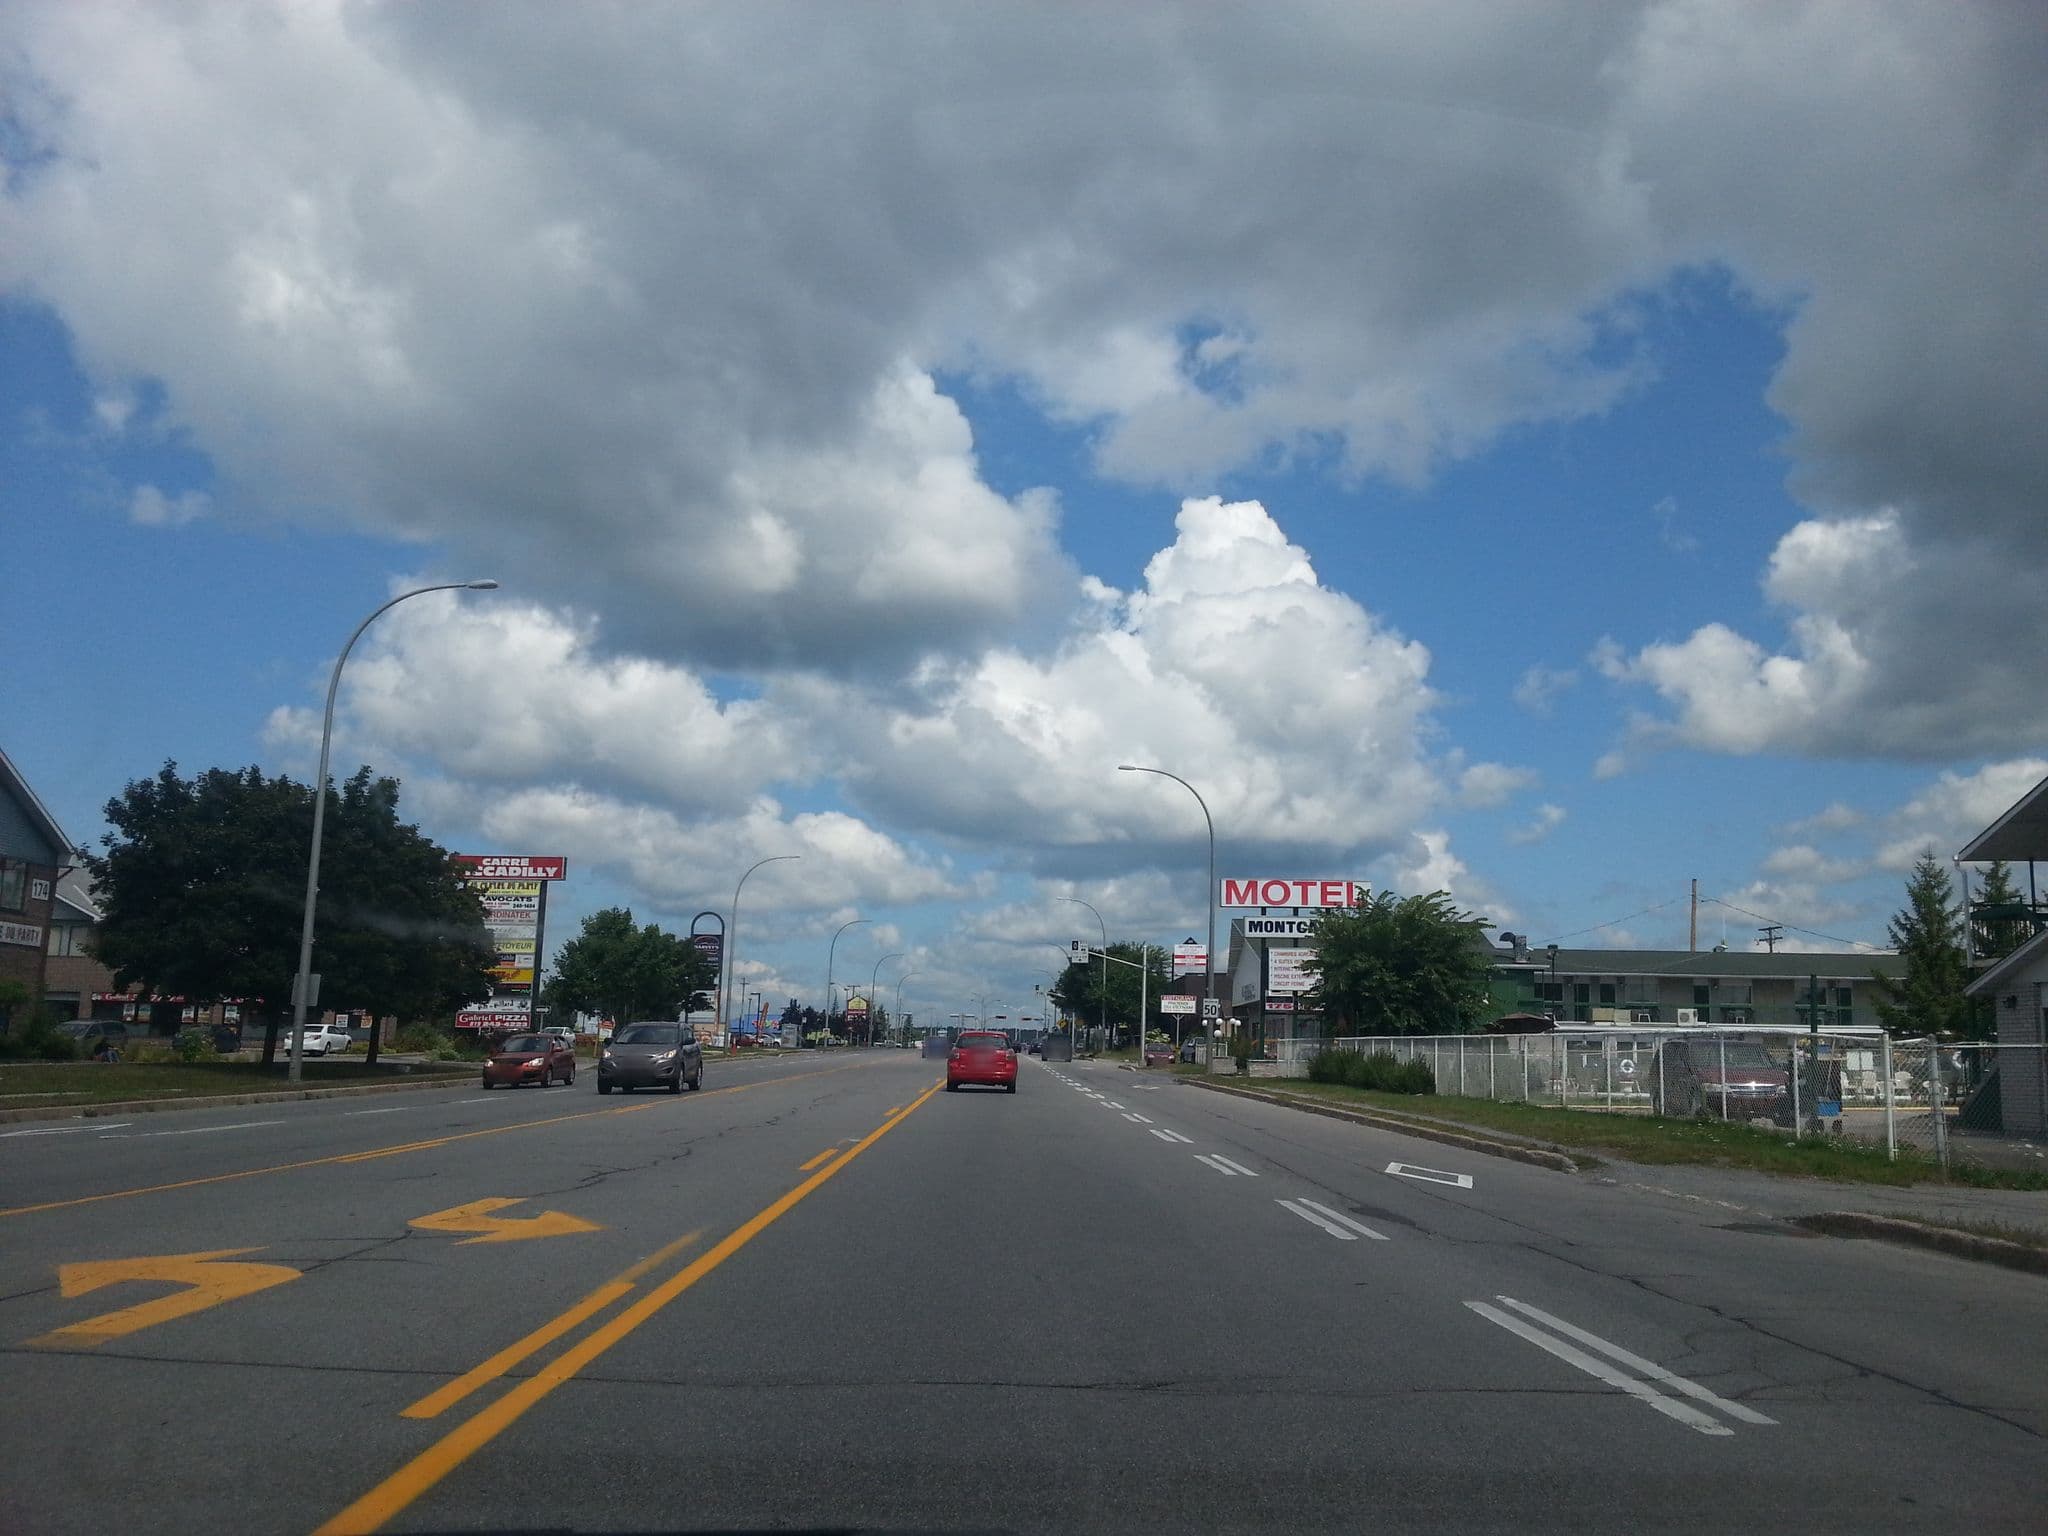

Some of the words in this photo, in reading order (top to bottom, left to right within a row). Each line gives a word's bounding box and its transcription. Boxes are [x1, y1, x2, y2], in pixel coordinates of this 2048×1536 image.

[34, 881, 49, 898] 174
[1225, 879, 1359, 907] MOTEL
[1204, 1004, 1217, 1016] 50
[459, 1014, 491, 1023] Gabriel
